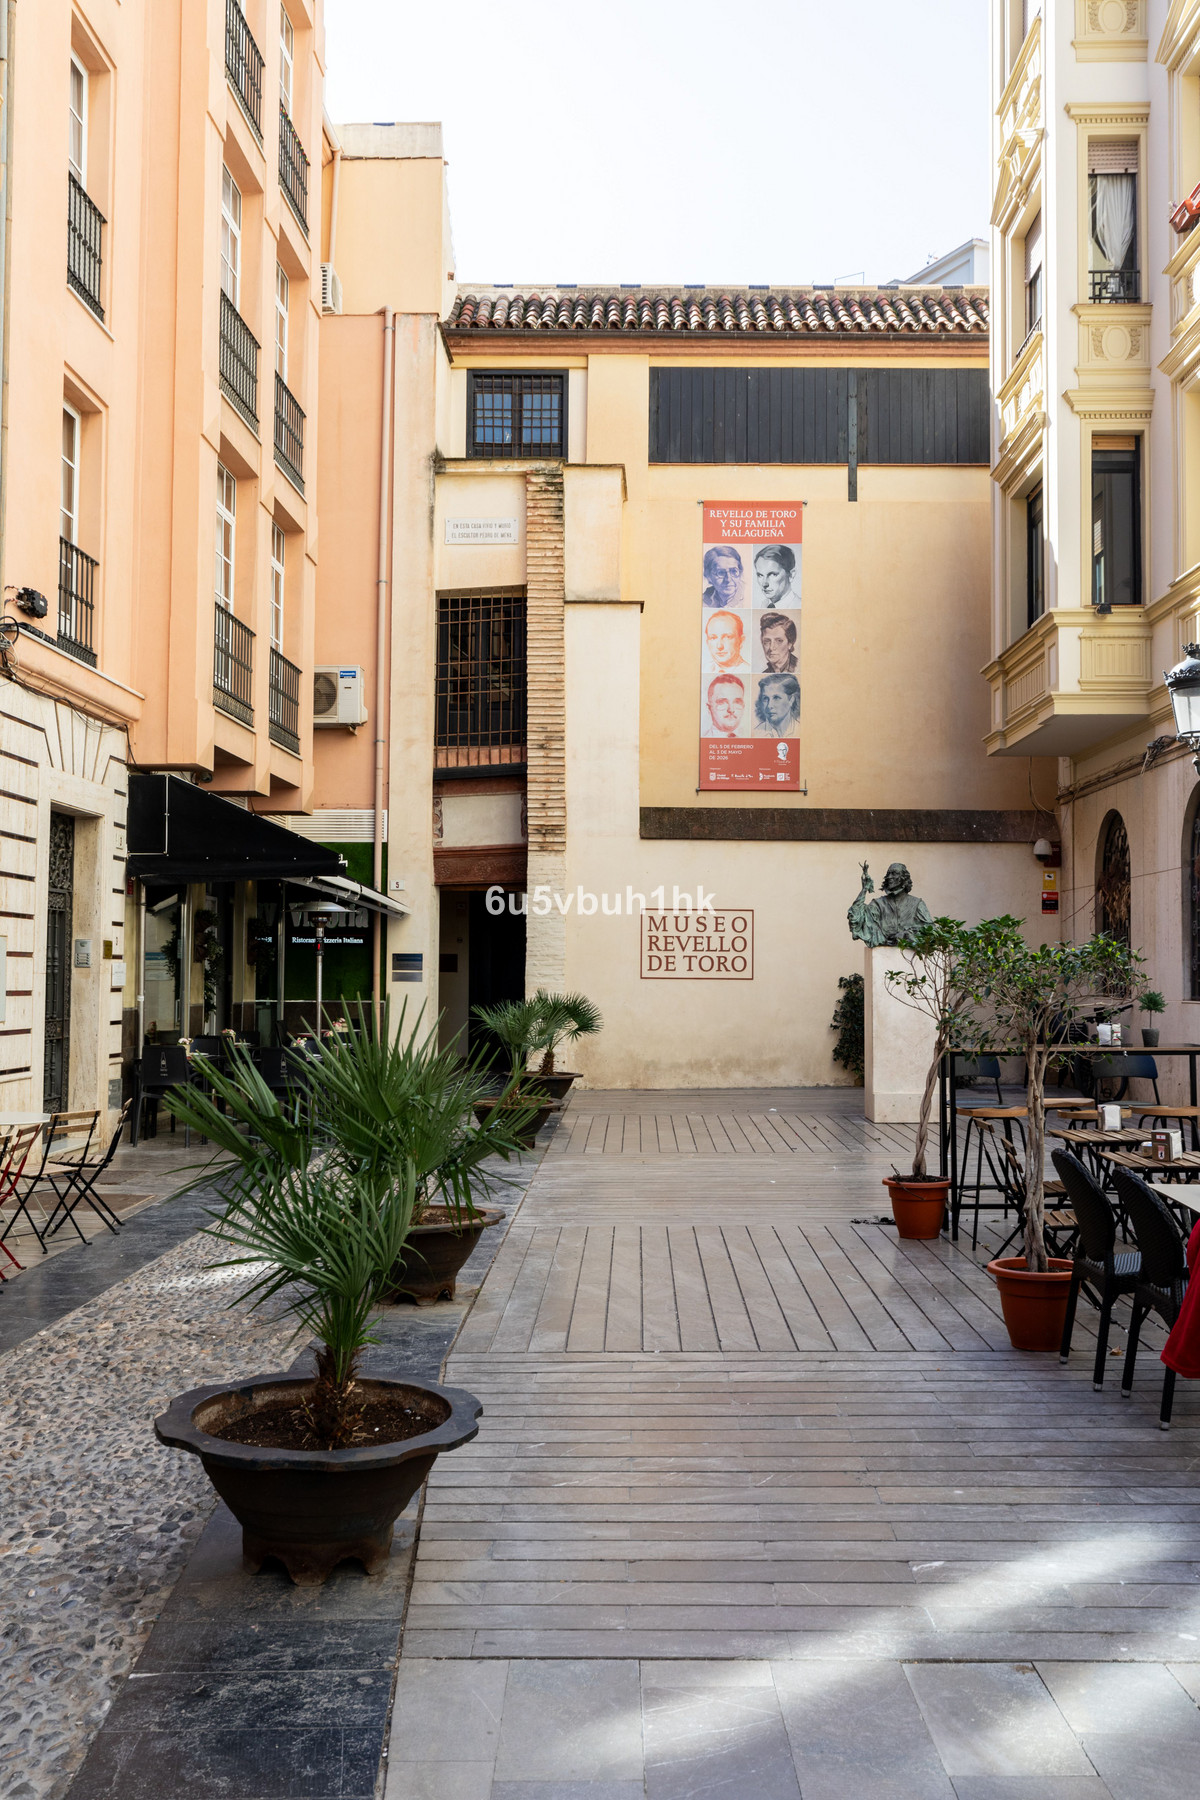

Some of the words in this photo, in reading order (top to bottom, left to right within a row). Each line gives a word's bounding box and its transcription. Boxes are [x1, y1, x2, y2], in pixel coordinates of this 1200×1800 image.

[709, 510, 753, 518] REVELLO
[755, 510, 768, 518] DE
[770, 510, 797, 518] TORO
[720, 520, 728, 528] Y
[729, 520, 742, 528] SU
[744, 520, 786, 528] FAMILIA
[721, 528, 784, 537] MALAGUEÑA
[395, 881, 400, 889] 5
[288, 902, 369, 929] Vioria
[647, 915, 748, 933] MUSEO
[322, 936, 343, 944] izzeria
[647, 935, 748, 953] REVELLO
[647, 955, 677, 972] DE
[682, 955, 748, 973] TORO
